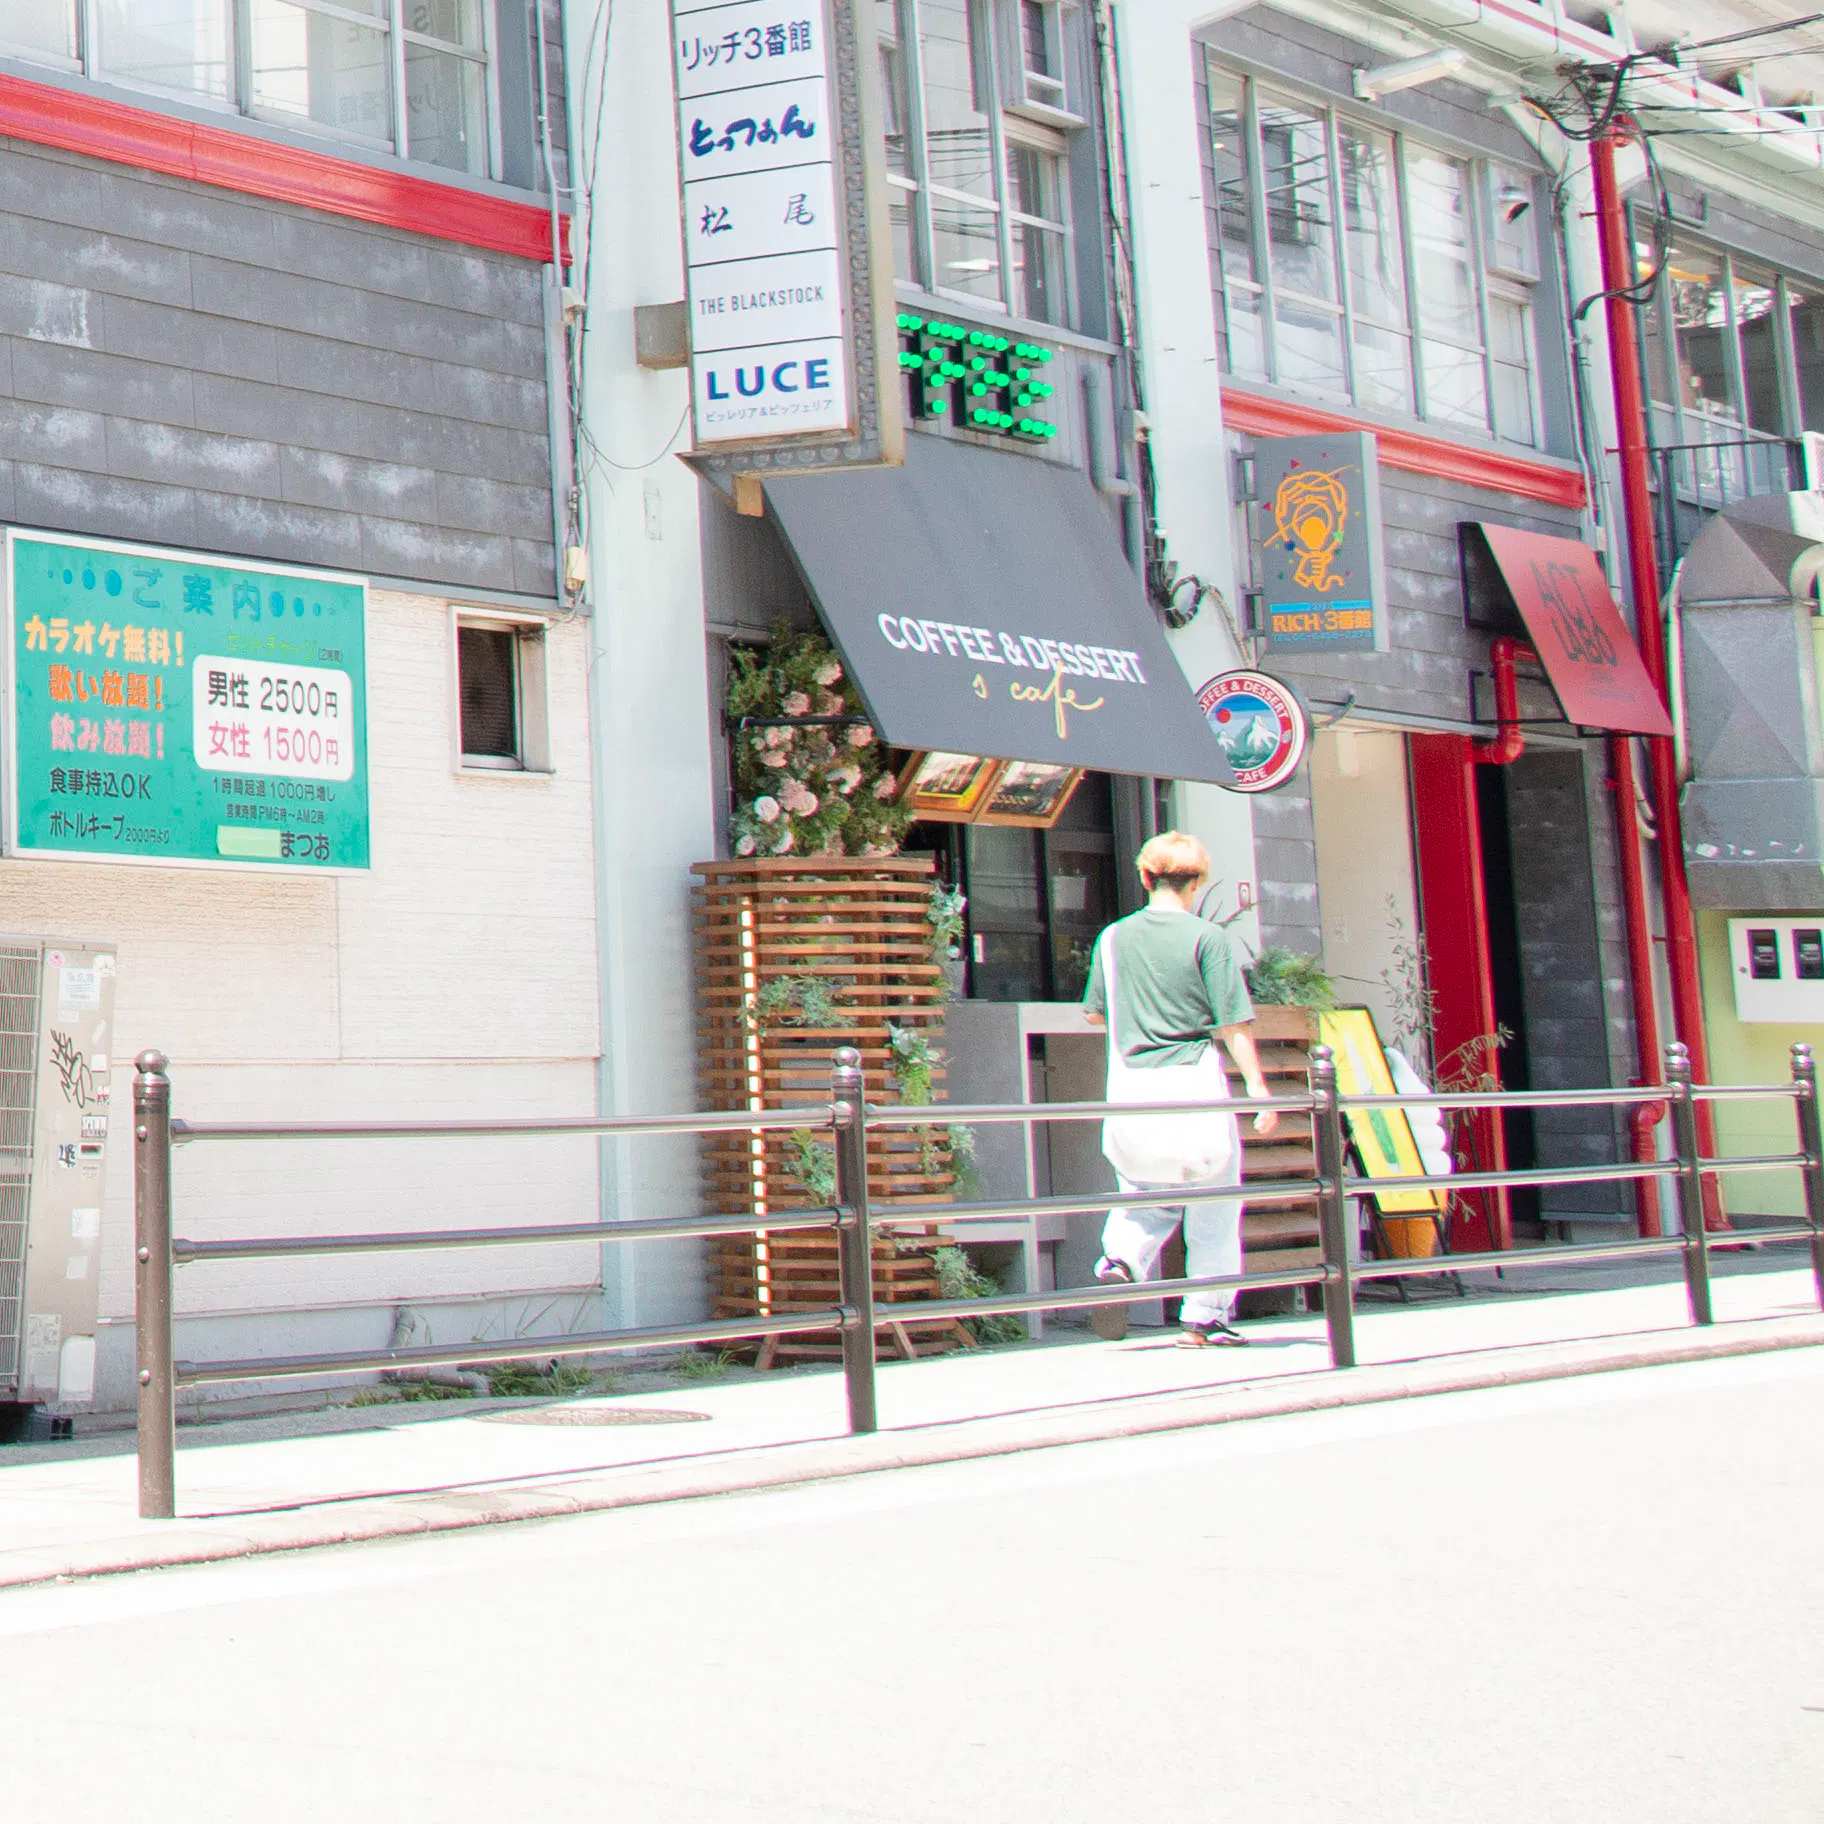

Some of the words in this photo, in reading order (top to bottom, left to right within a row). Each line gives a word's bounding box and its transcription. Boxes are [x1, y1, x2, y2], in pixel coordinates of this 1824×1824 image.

[680, 19, 813, 72] リッチ3番館
[698, 297, 726, 316] THE
[730, 284, 825, 312] BLACKSTOCK
[706, 357, 831, 400] LUCE
[132, 568, 261, 622] ご案内
[24, 613, 185, 667] カラオケ無料!
[878, 612, 1006, 665] COFFEE
[1019, 634, 1149, 685] DESSERT
[48, 663, 164, 712] 歌い放題!
[207, 670, 250, 709] 男性
[259, 676, 338, 719] 2500円
[1200, 683, 1230, 714] FFEE
[1230, 680, 1241, 692] &
[1243, 679, 1291, 719] DESSERT
[50, 712, 165, 761] 飲み放題!
[207, 720, 251, 758] 女性
[263, 725, 339, 766] 1500円
[49, 766, 152, 800] 食事持込OK
[1234, 767, 1268, 784] CAFE
[280, 830, 331, 861] まつお
